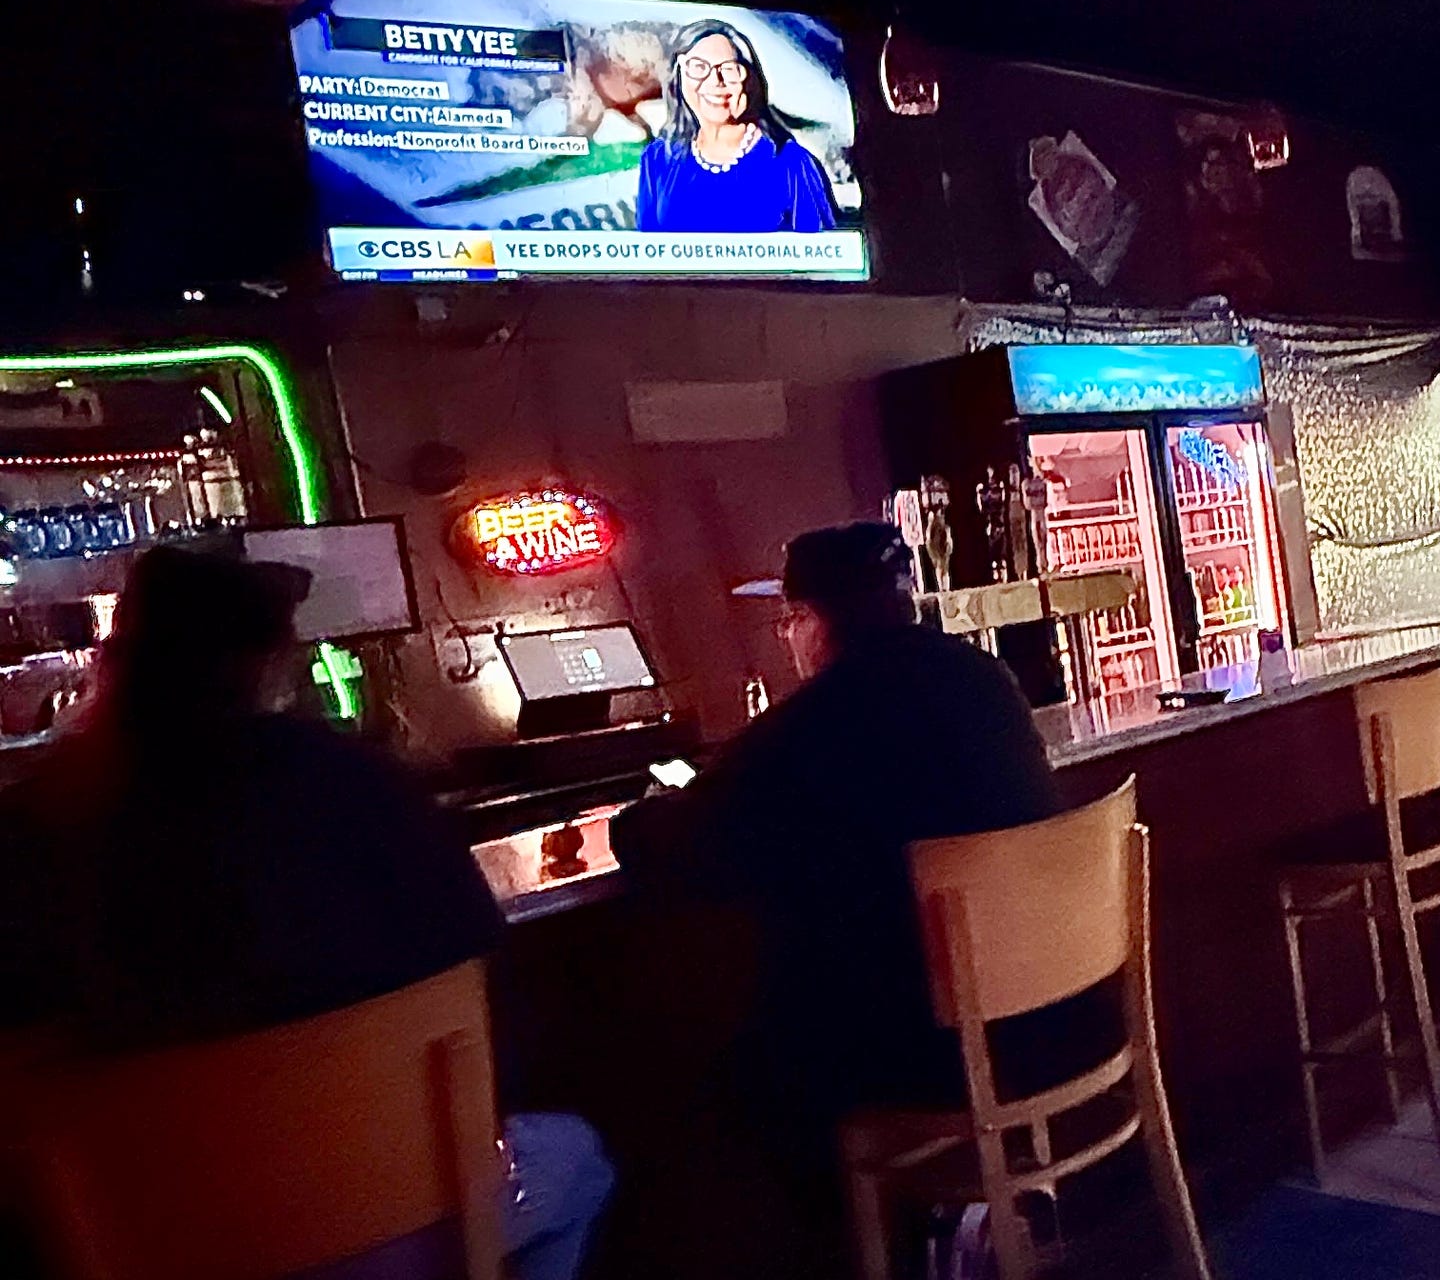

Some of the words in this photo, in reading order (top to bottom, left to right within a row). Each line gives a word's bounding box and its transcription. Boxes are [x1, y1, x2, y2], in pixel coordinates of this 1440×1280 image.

[384, 24, 464, 53] BETTY
[466, 29, 518, 56] YEE
[299, 75, 360, 95] PARTY:
[365, 80, 441, 94] Democrat
[304, 101, 388, 122] CURRENT
[390, 105, 433, 124] CITY:
[437, 107, 503, 124] Alameda
[308, 128, 396, 147] Profession:
[403, 134, 475, 150] Nonprofit
[481, 136, 524, 150] Board
[528, 138, 586, 152] Director
[381, 240, 432, 258] CBS
[437, 240, 472, 259] LA
[506, 243, 540, 258] YEE
[544, 243, 602, 258] DROPS
[606, 243, 640, 258] OUT
[645, 244, 666, 258] OF
[671, 244, 801, 259] GUBERNATORIAL
[804, 245, 843, 259] RACE
[476, 502, 570, 544] BEER
[515, 521, 601, 560] WINE
